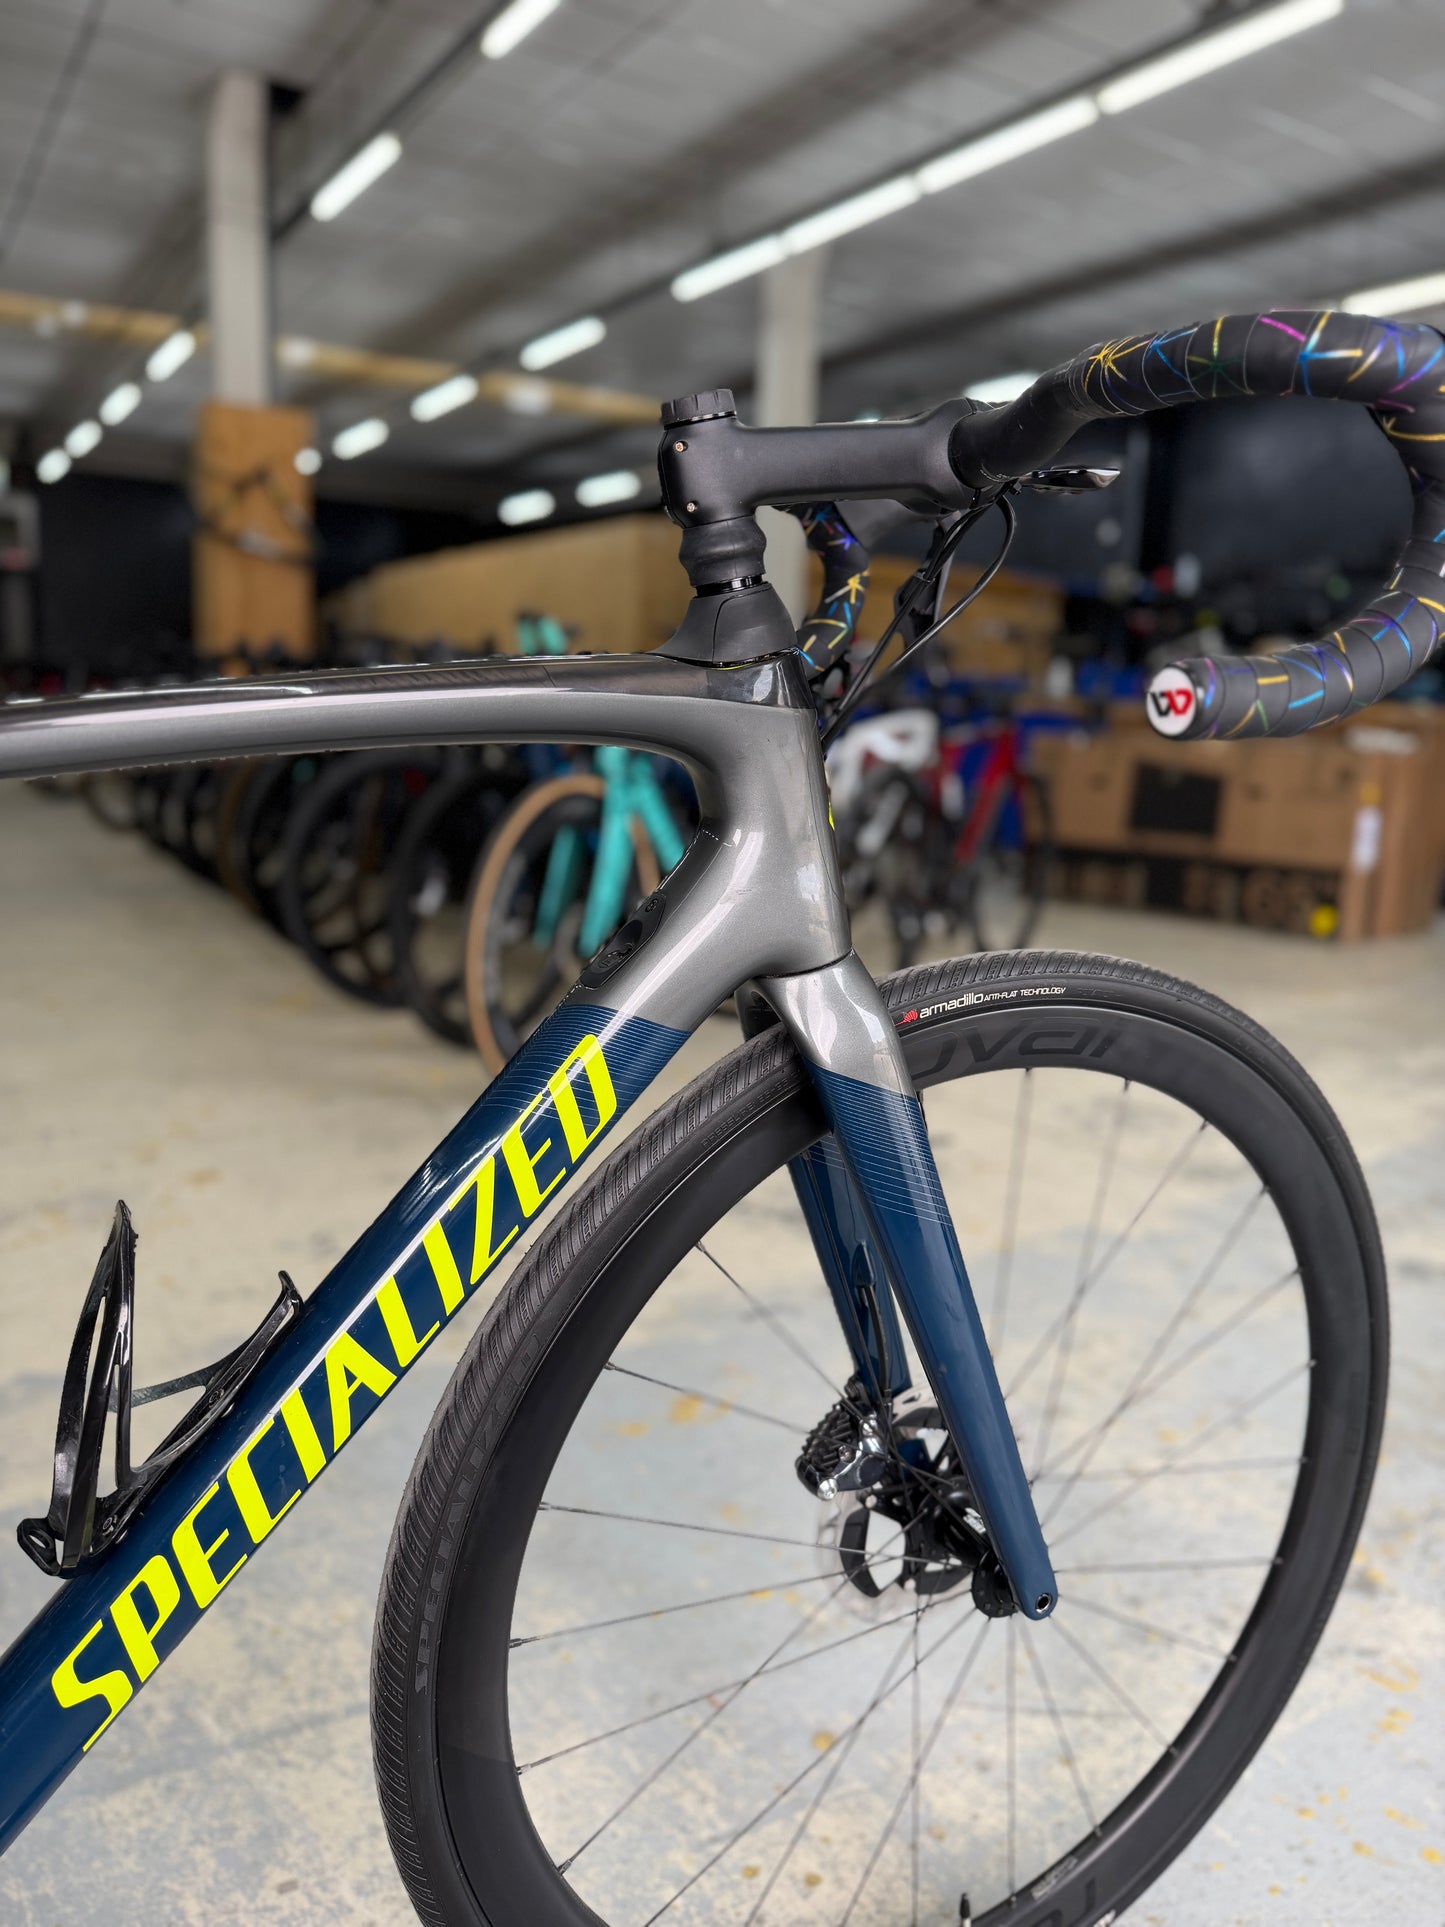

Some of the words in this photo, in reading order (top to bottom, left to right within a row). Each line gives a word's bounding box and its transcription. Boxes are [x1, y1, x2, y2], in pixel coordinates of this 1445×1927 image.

[919, 992, 984, 1019] armadillo
[1020, 987, 1067, 997] TECHNOLOGY
[51, 1035, 618, 1751] SPECIALIZED
